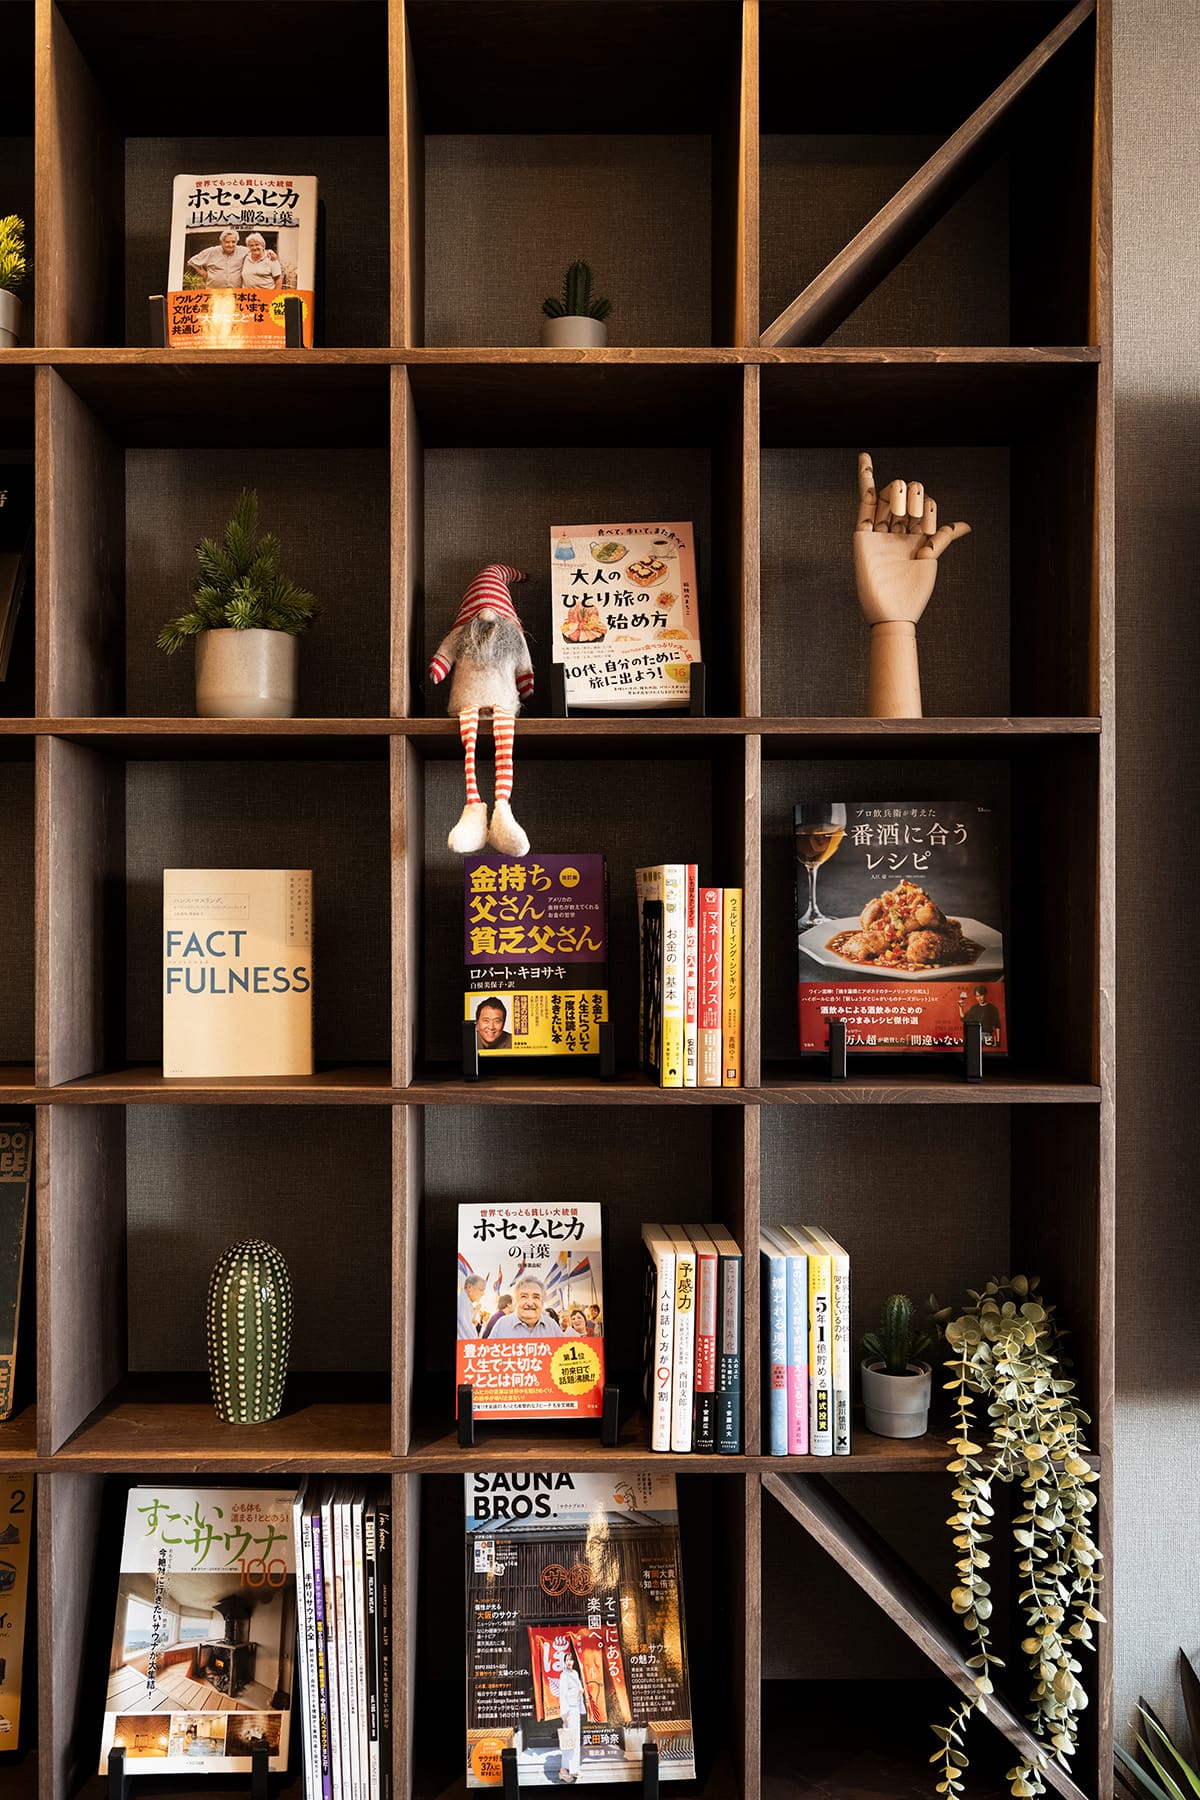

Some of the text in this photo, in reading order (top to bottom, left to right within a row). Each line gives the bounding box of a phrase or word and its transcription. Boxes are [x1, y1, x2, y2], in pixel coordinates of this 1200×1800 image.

[195, 179, 294, 188] 世界でもっとも貧しい大統領
[188, 187, 300, 209] ホセ・ムヒカ
[192, 210, 293, 224] 日本人へ贈る言葉
[570, 569, 621, 586] 大人の
[561, 590, 650, 608] ひとり旅の
[606, 611, 668, 630] 始め方
[589, 667, 663, 689] 旅に出よう!
[866, 850, 932, 871] レシピ
[469, 863, 552, 893] 金持ち
[469, 894, 546, 924] 父さん
[167, 931, 247, 957] FACT
[469, 925, 603, 956] 貧乏父さん
[729, 898, 738, 1000] ウェルビーイング・シンキング
[707, 911, 719, 1004] マネーバイアス
[167, 967, 311, 994] FULNESS
[470, 966, 567, 980] ロバート・キヨサキ
[551, 994, 562, 1044] おきたい本
[592, 994, 603, 1025] お金と
[565, 994, 576, 1052] 一度は読んで
[578, 994, 590, 1051] 人生について
[480, 1208, 578, 1217] 世界でもっとも貧しい大統領
[473, 1217, 585, 1241] ホセ・ムヒカ
[508, 1243, 550, 1259] の言葉
[677, 1263, 693, 1310] 予感力
[463, 1342, 553, 1358] 豊かさとは何か、
[563, 1346, 585, 1361] 第1位
[657, 1290, 671, 1402] 人は話し方が9割
[463, 1358, 543, 1373] 人生で大切な
[818, 1391, 827, 1430] 株式投資
[474, 1473, 575, 1493] SAUNA
[9, 1490, 26, 1513] 2
[231, 1503, 262, 1512] 心も体も
[474, 1495, 558, 1520] BROS.
[137, 1498, 224, 1545] すごい
[184, 1523, 288, 1567] サウナ
[237, 1558, 287, 1588] 100
[587, 1596, 604, 1648] 楽園へ。
[620, 1596, 633, 1627] すぐ
[604, 1596, 622, 1682] そこにある、
[630, 1654, 660, 1665] の魅力。
[583, 1733, 619, 1745] 武田玲奈
